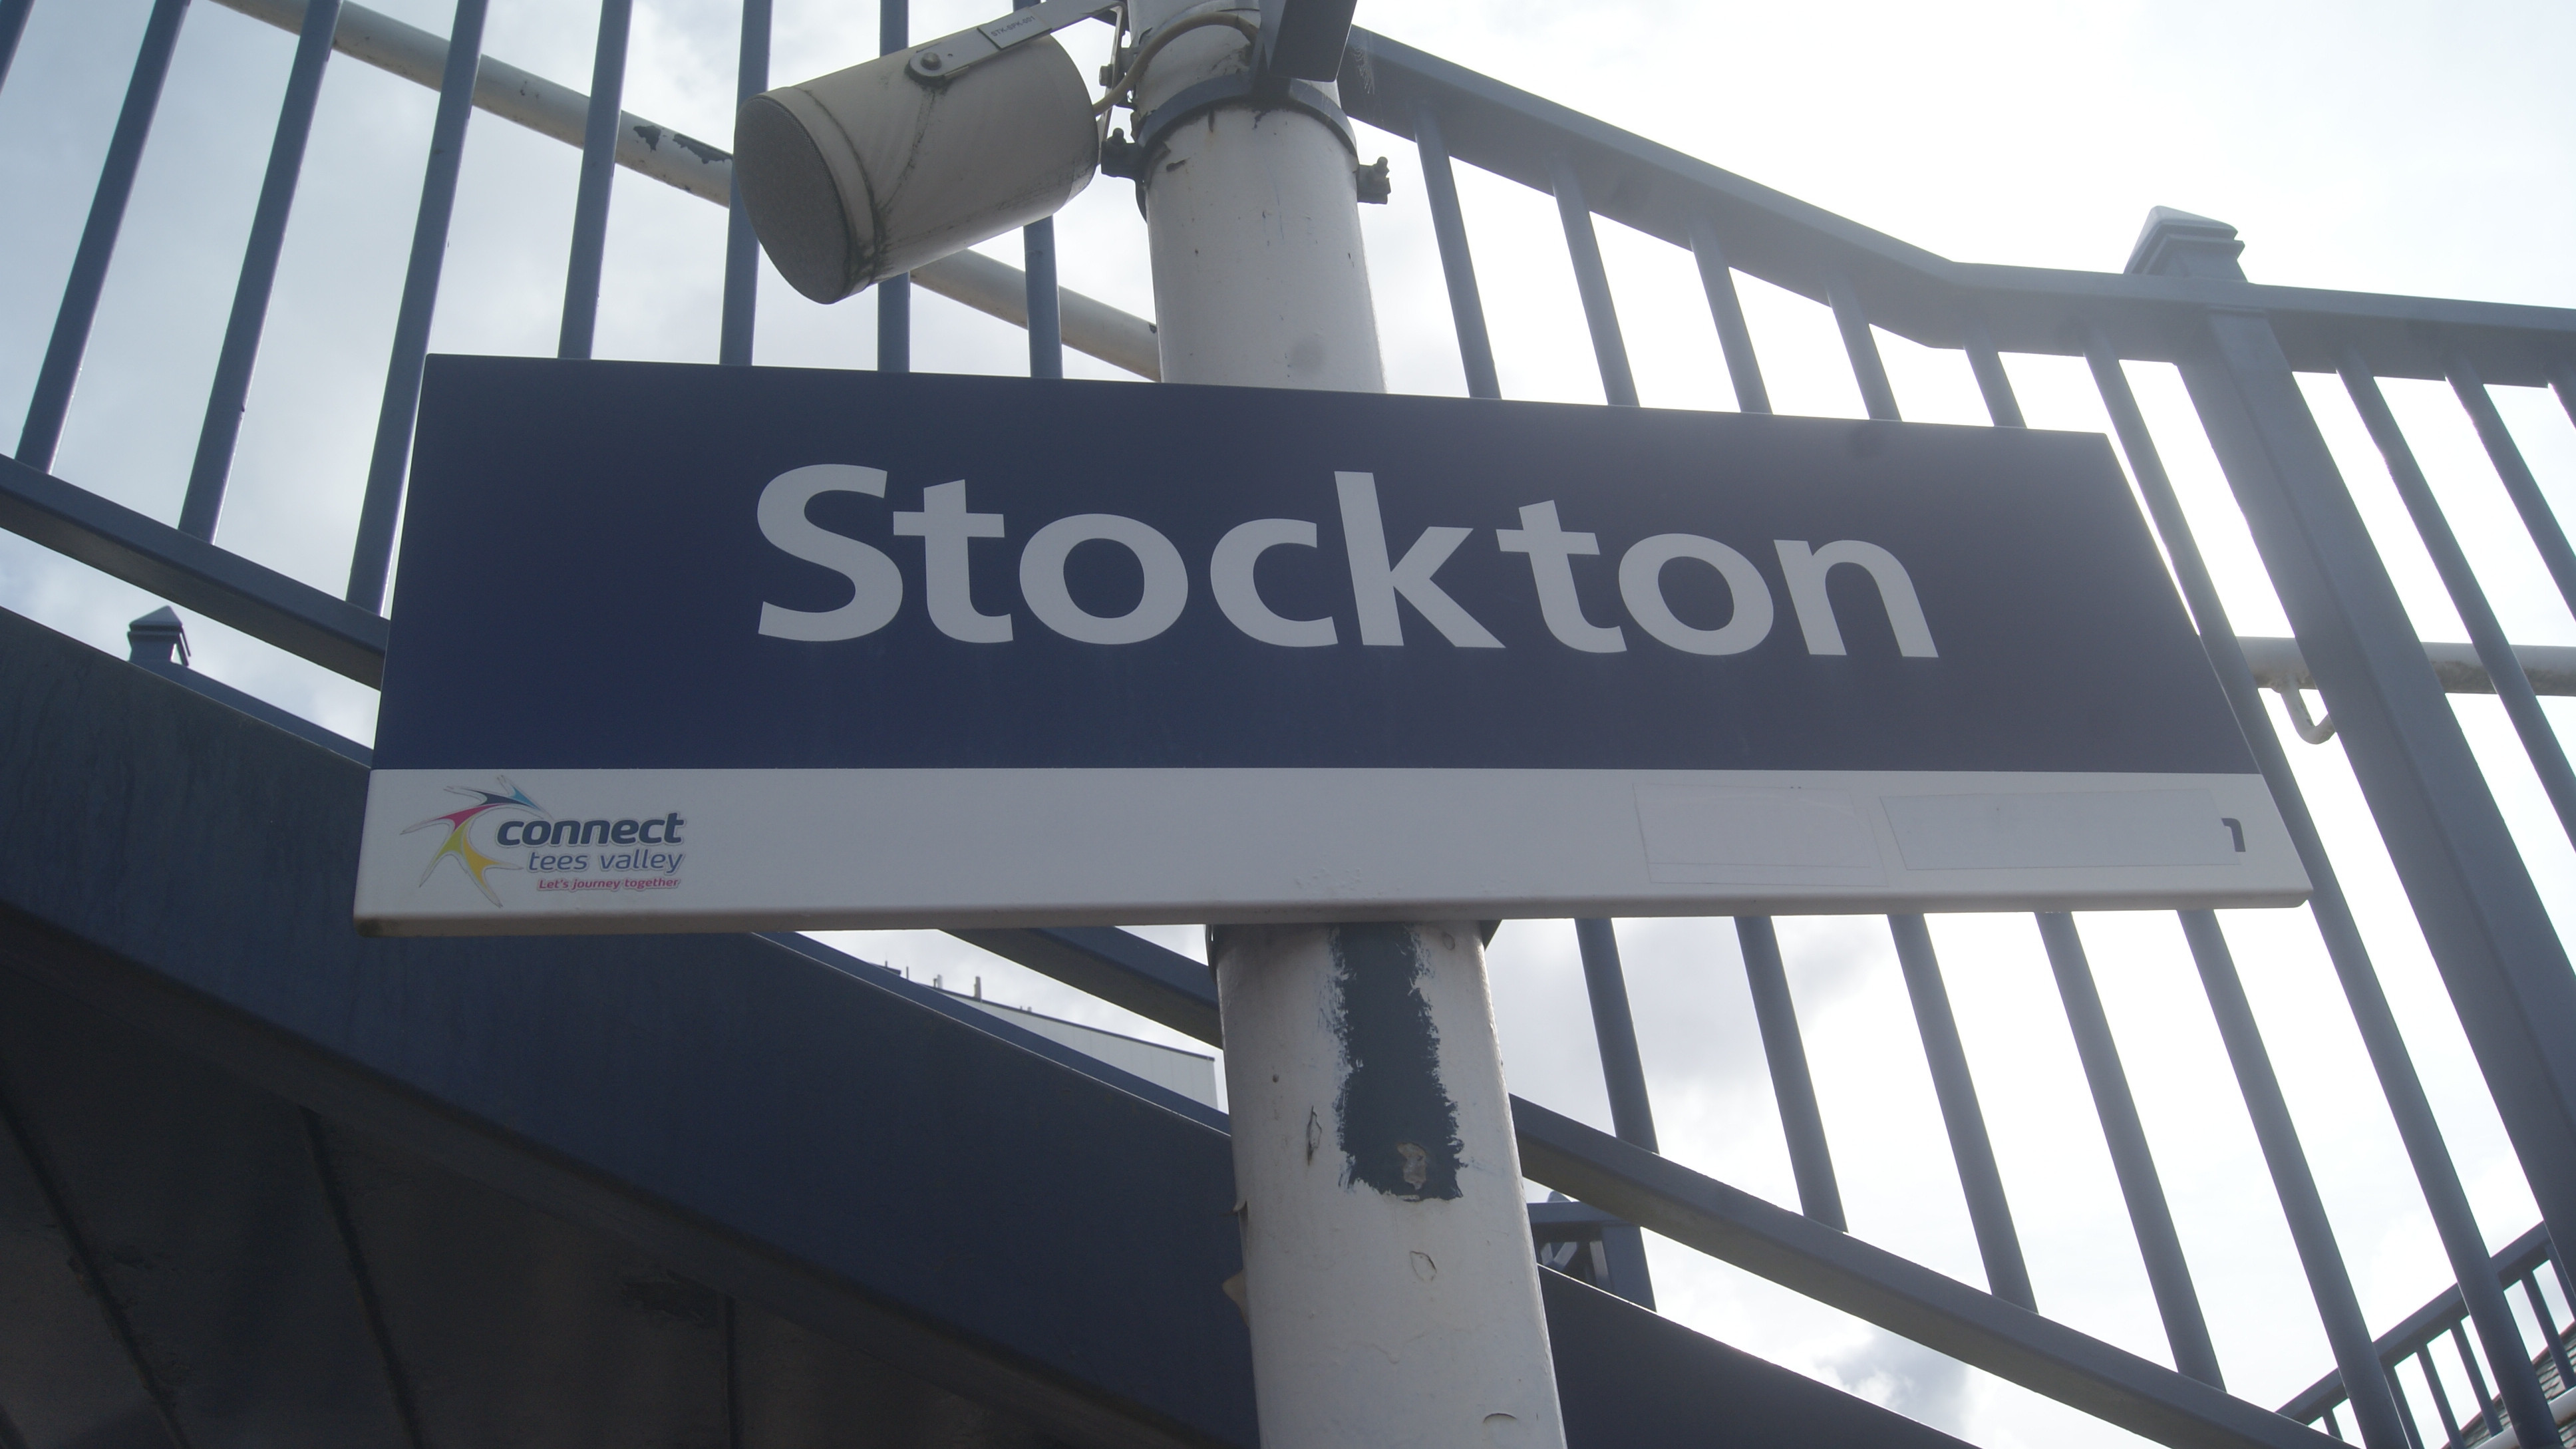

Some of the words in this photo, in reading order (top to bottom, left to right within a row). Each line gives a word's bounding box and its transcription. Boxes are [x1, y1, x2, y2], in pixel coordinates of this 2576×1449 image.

[756, 463, 1940, 659] Stockton
[497, 812, 685, 846] connect
[528, 852, 588, 871] tees
[600, 849, 683, 874] valley
[539, 879, 569, 889] Let's
[571, 879, 621, 889] journey
[624, 878, 679, 889] together
